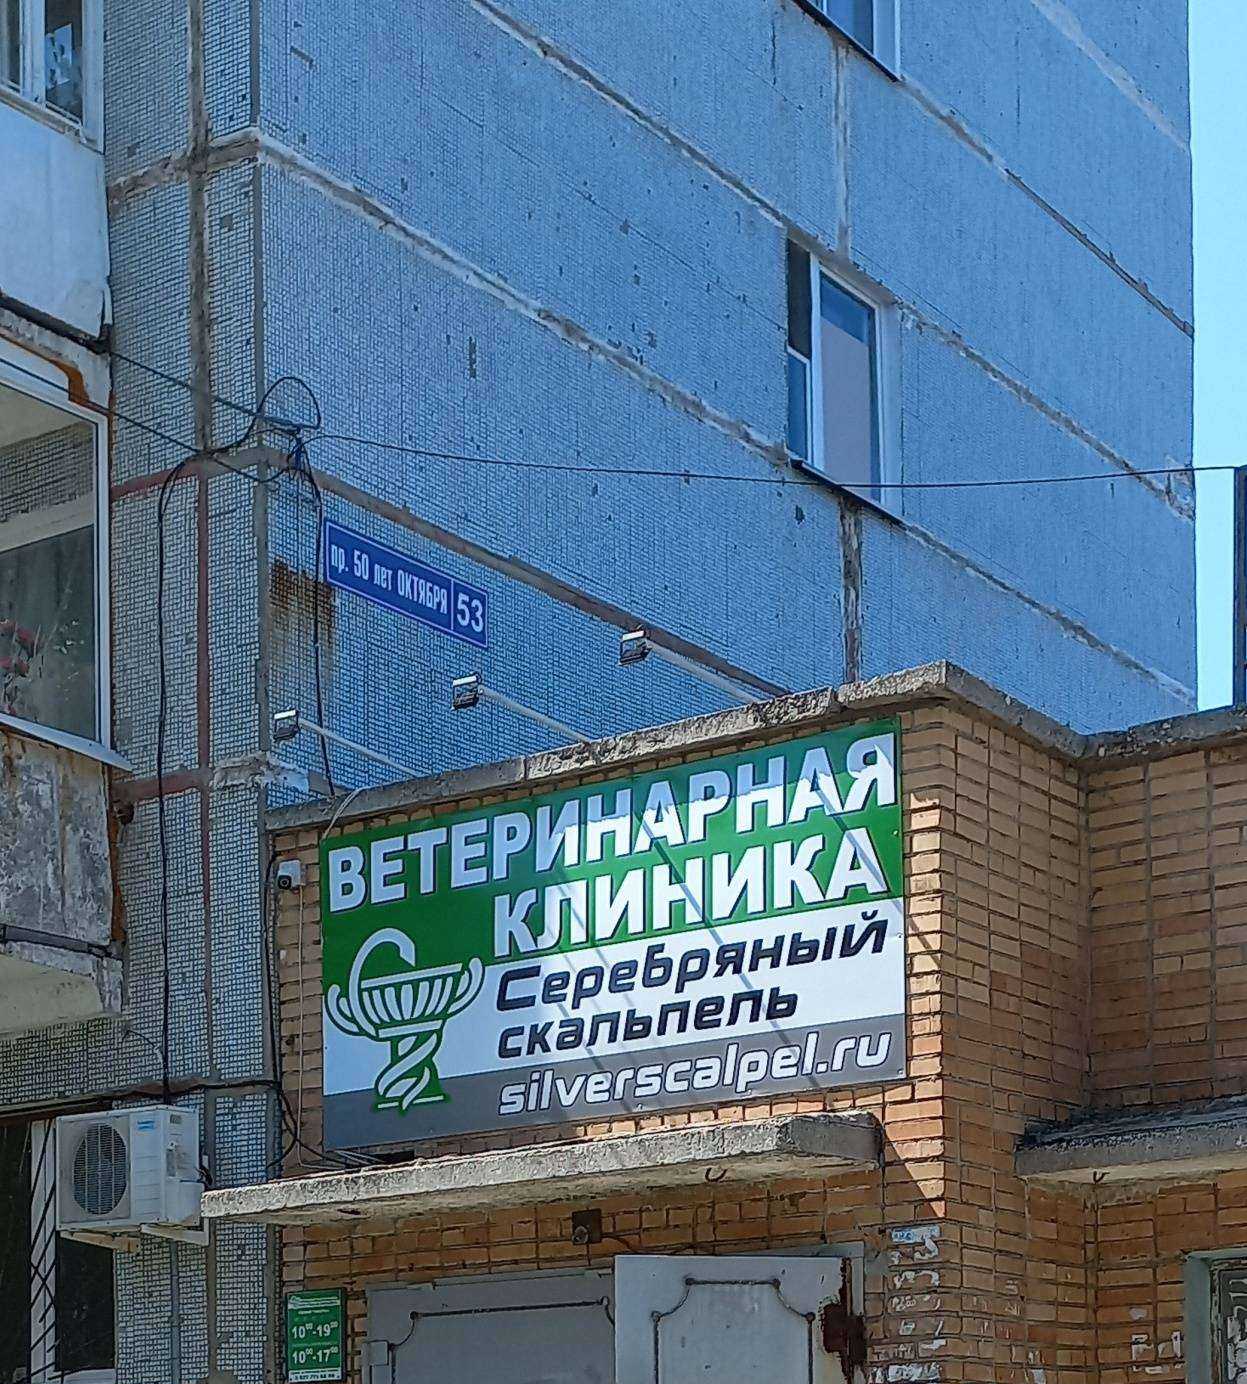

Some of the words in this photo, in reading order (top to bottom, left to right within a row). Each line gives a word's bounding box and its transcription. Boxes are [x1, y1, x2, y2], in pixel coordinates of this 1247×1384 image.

[331, 544, 349, 574] пр.
[353, 549, 369, 581] 50
[374, 564, 393, 591] лет
[397, 569, 448, 615] ОКТЯБРЯ
[456, 592, 484, 633] 53
[327, 731, 898, 914] ВЕТЕРИНАРНАЯ
[493, 827, 889, 960] КЛИНИКА
[497, 909, 889, 1011] Серебряный
[498, 985, 799, 1060] скальпель
[498, 1030, 893, 1116] silverscalpel.ru
